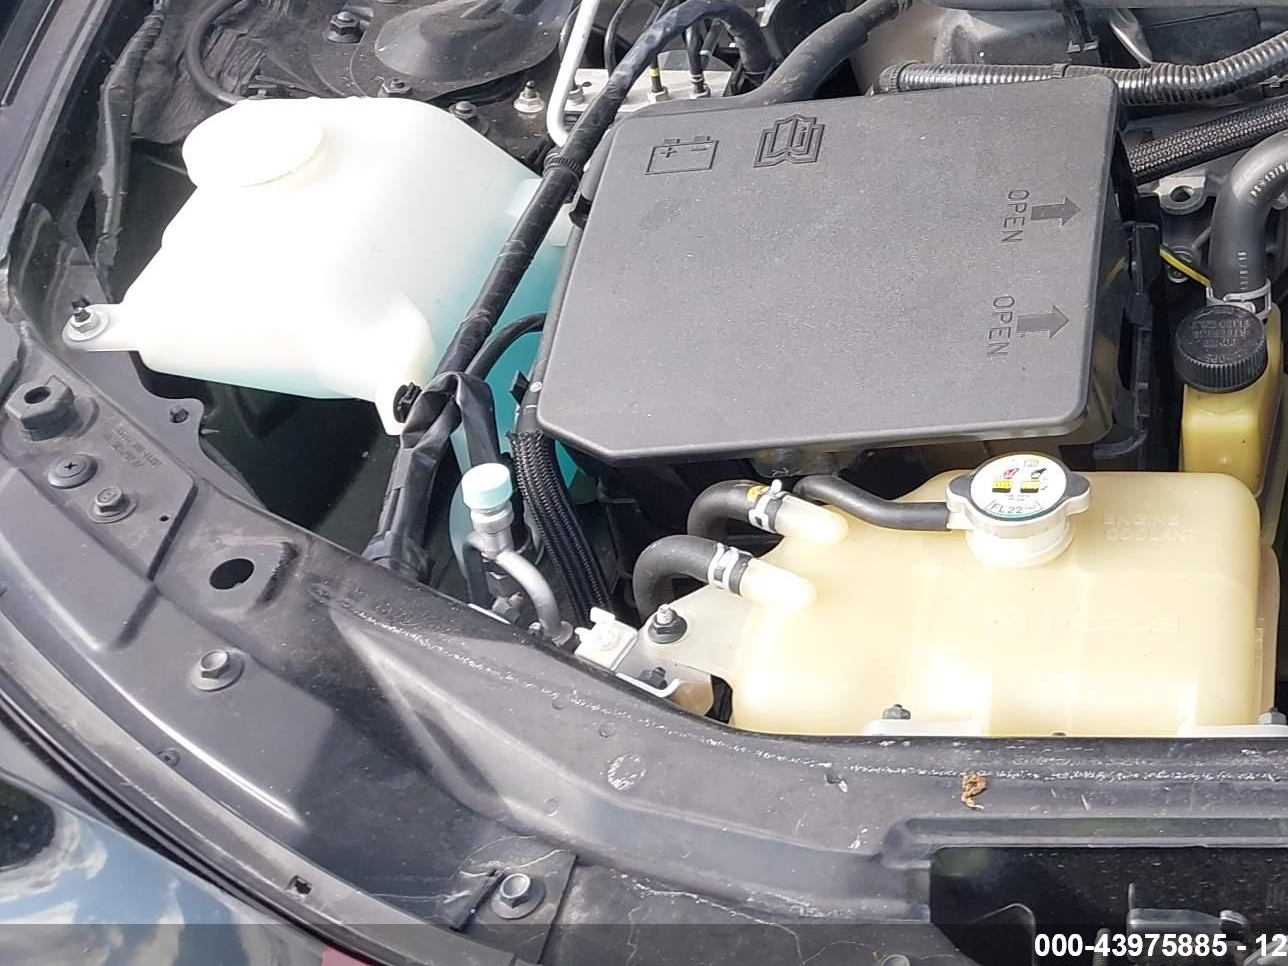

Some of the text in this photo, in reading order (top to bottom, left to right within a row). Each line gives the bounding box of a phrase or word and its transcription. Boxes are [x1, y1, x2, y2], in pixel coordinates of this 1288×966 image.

[1001, 189, 1030, 243] OPEN
[986, 295, 1015, 357] OPEN
[990, 502, 1023, 514] FL22
[1103, 513, 1181, 526] ENGINE
[1106, 529, 1195, 542] COOLANT
